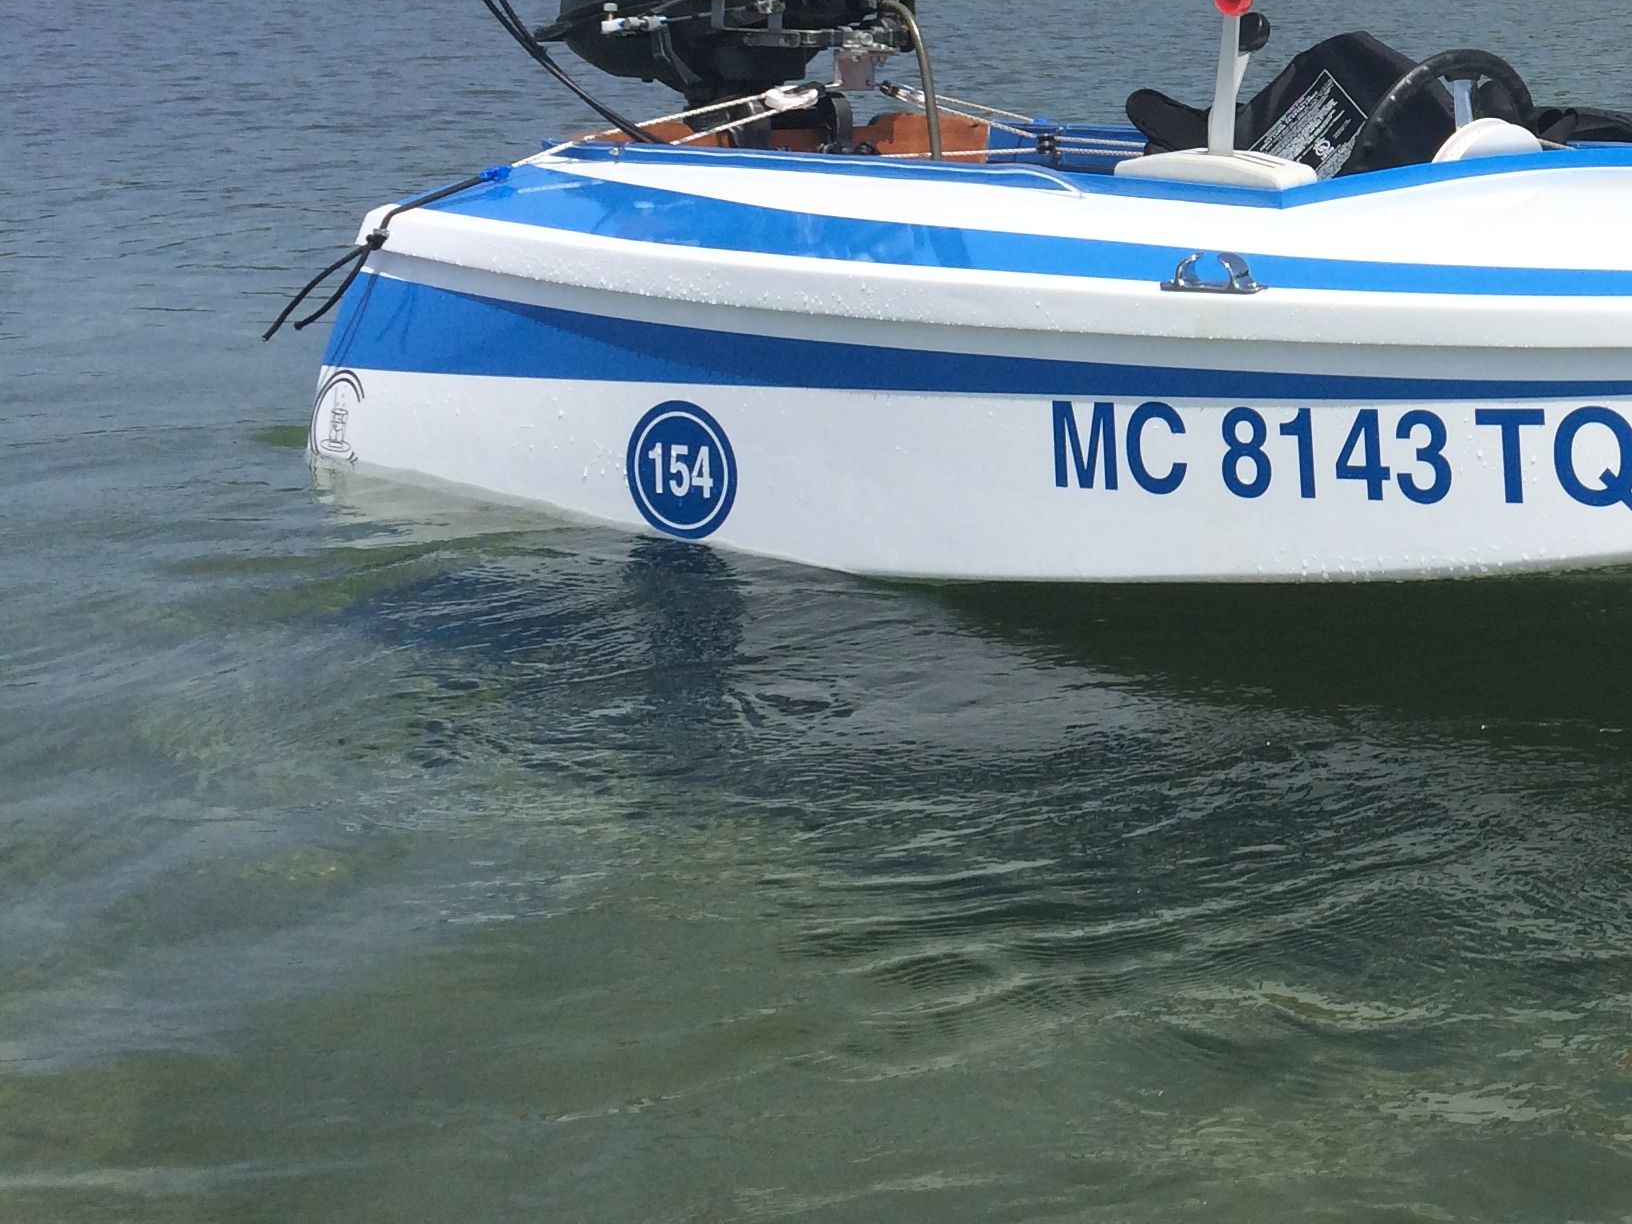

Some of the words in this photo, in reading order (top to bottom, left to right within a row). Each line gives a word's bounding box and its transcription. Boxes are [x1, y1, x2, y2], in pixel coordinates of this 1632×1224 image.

[648, 442, 714, 499] 154
[1051, 400, 1188, 495] MC
[1221, 406, 1452, 505] 8143
